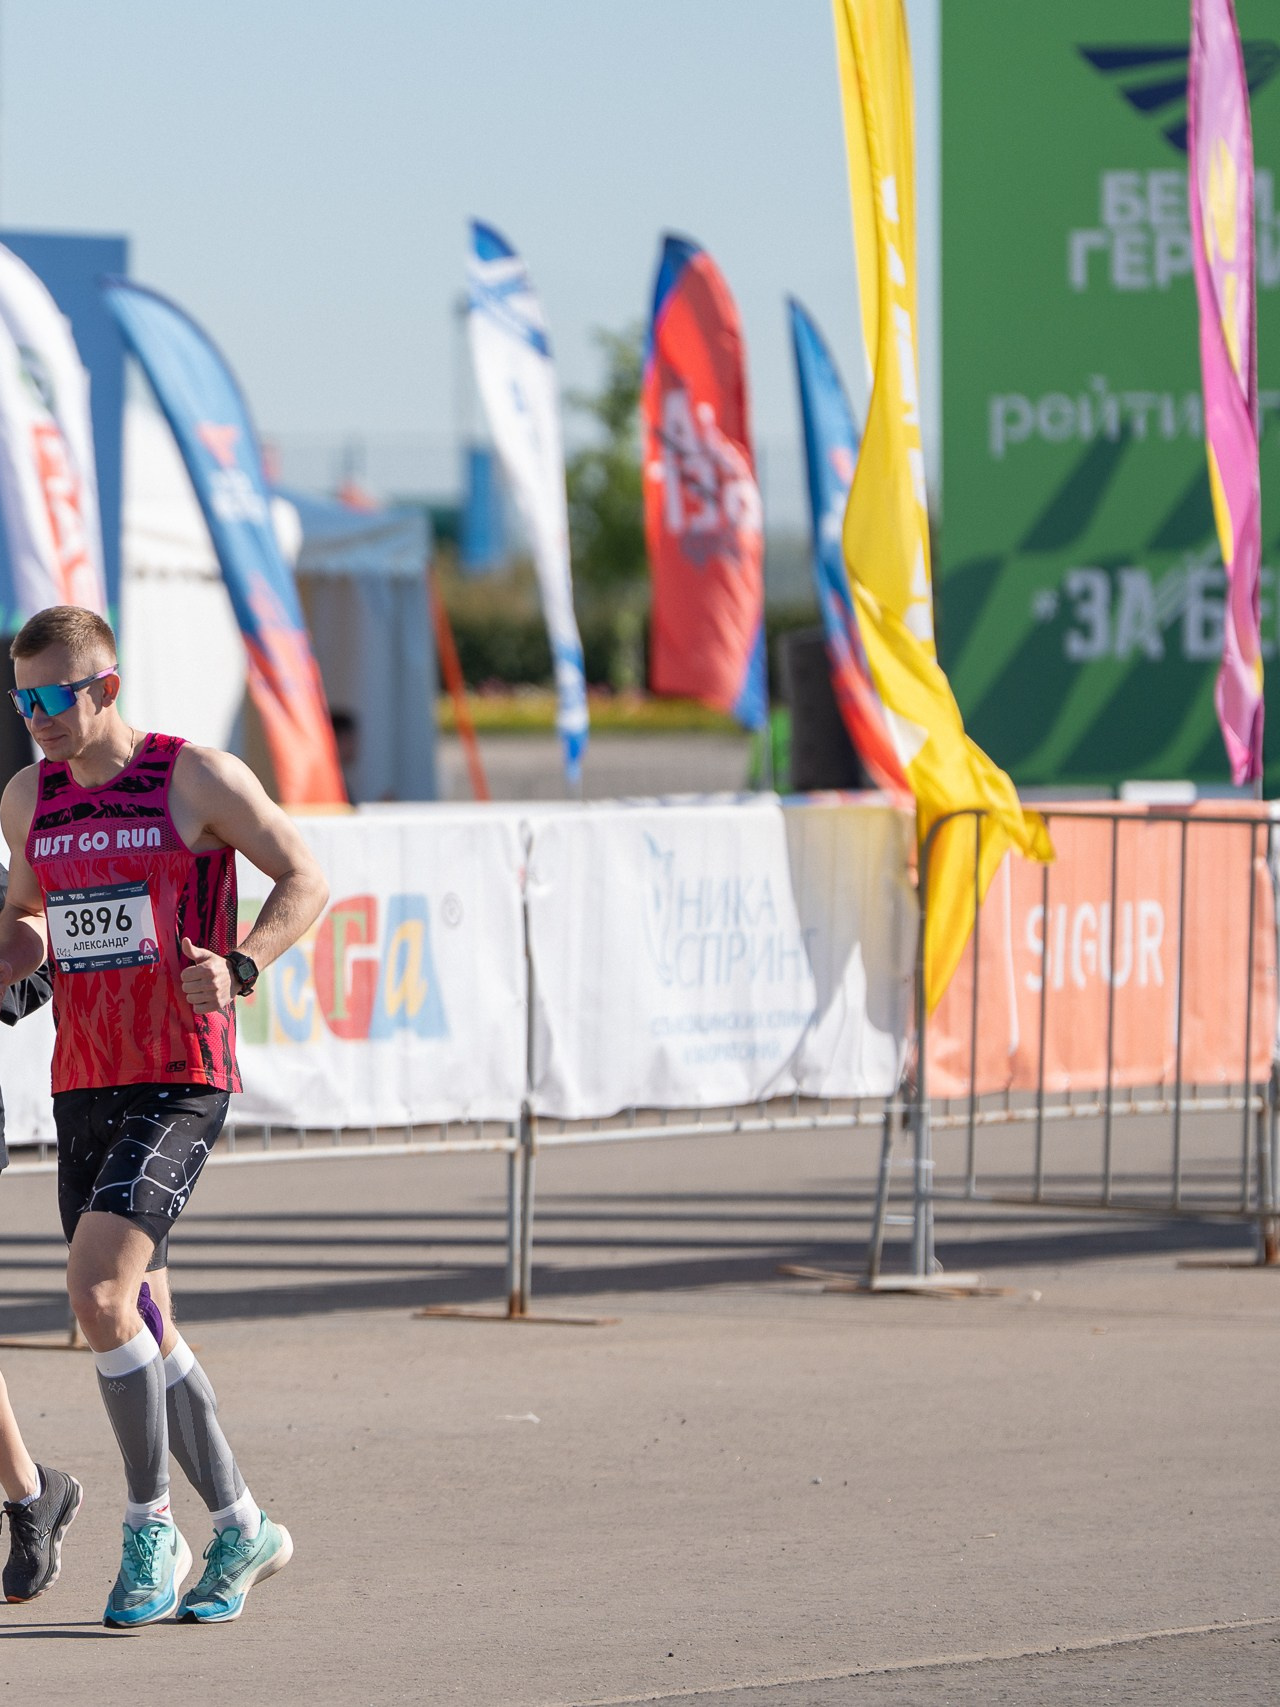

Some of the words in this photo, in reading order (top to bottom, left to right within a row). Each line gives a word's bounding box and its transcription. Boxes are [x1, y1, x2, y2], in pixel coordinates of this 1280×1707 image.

[1069, 227, 1280, 292] ГЕР
[34, 834, 74, 858] JUST
[78, 831, 109, 852] GO
[116, 827, 161, 849] RUN
[64, 904, 133, 937] 3896
[677, 877, 778, 929] НИКА
[73, 936, 130, 951] АЛЕКСАНДР
[1024, 898, 1165, 993] SIGUR
